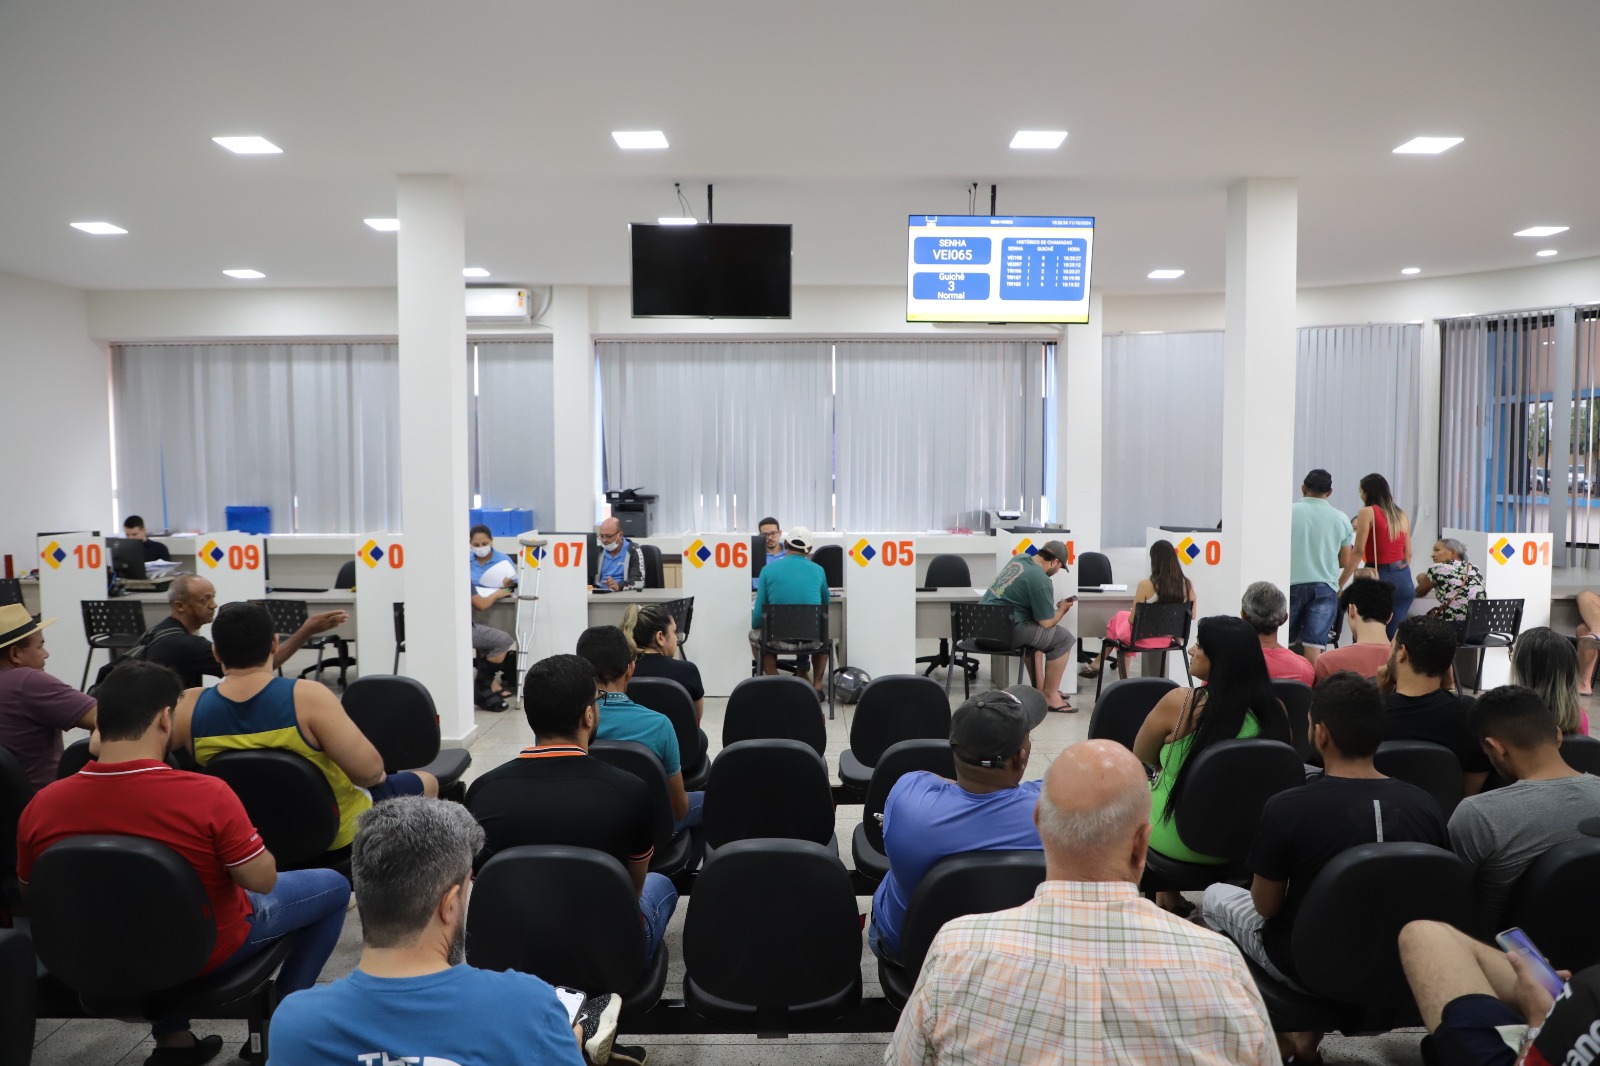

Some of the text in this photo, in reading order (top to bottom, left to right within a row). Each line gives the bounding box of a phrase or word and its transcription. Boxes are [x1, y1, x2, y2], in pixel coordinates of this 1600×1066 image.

[932, 249, 973, 260] VEI065
[938, 239, 967, 247] SENHA
[938, 272, 965, 281] Guichê
[947, 281, 955, 292] 3
[937, 292, 965, 300] Normal
[73, 543, 102, 569] 10
[229, 544, 259, 570] 09
[553, 542, 584, 568] 07
[715, 542, 748, 569] 06
[881, 540, 914, 567] 05
[1522, 541, 1549, 566] 01
